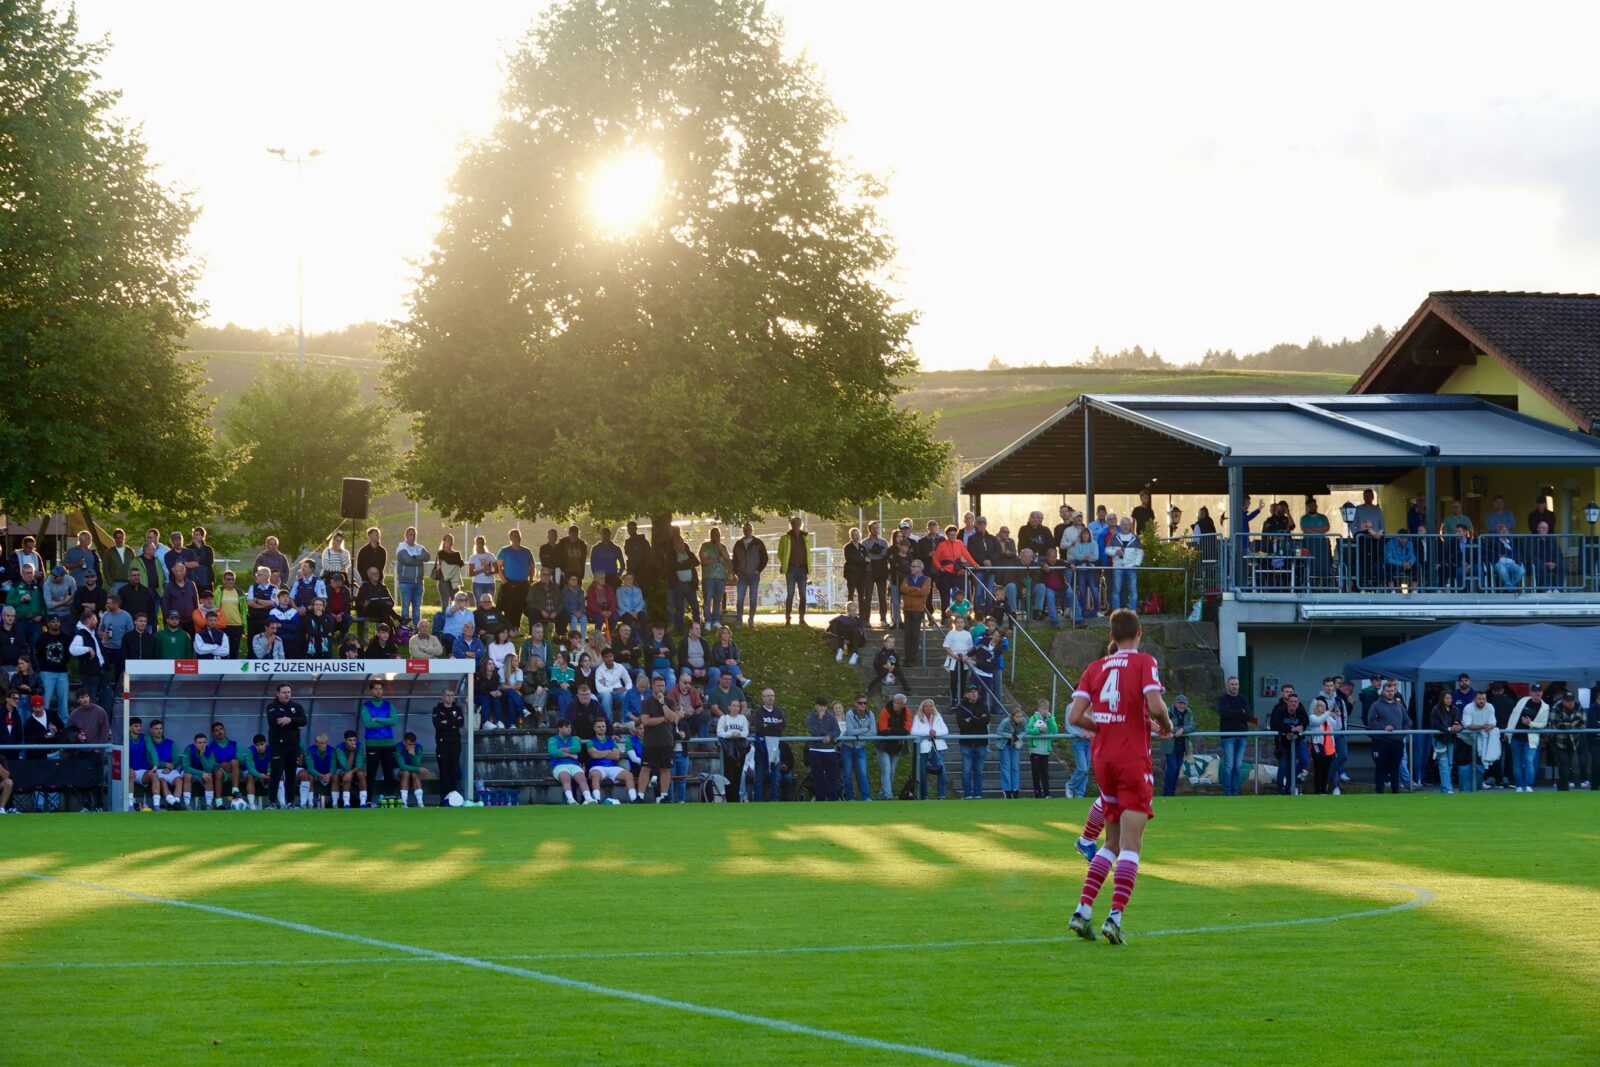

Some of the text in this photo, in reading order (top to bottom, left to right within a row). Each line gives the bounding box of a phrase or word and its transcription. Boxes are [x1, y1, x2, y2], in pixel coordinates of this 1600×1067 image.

[254, 662, 365, 673] FC ZUZENHAUSEN
[1100, 668, 1120, 712] 4
